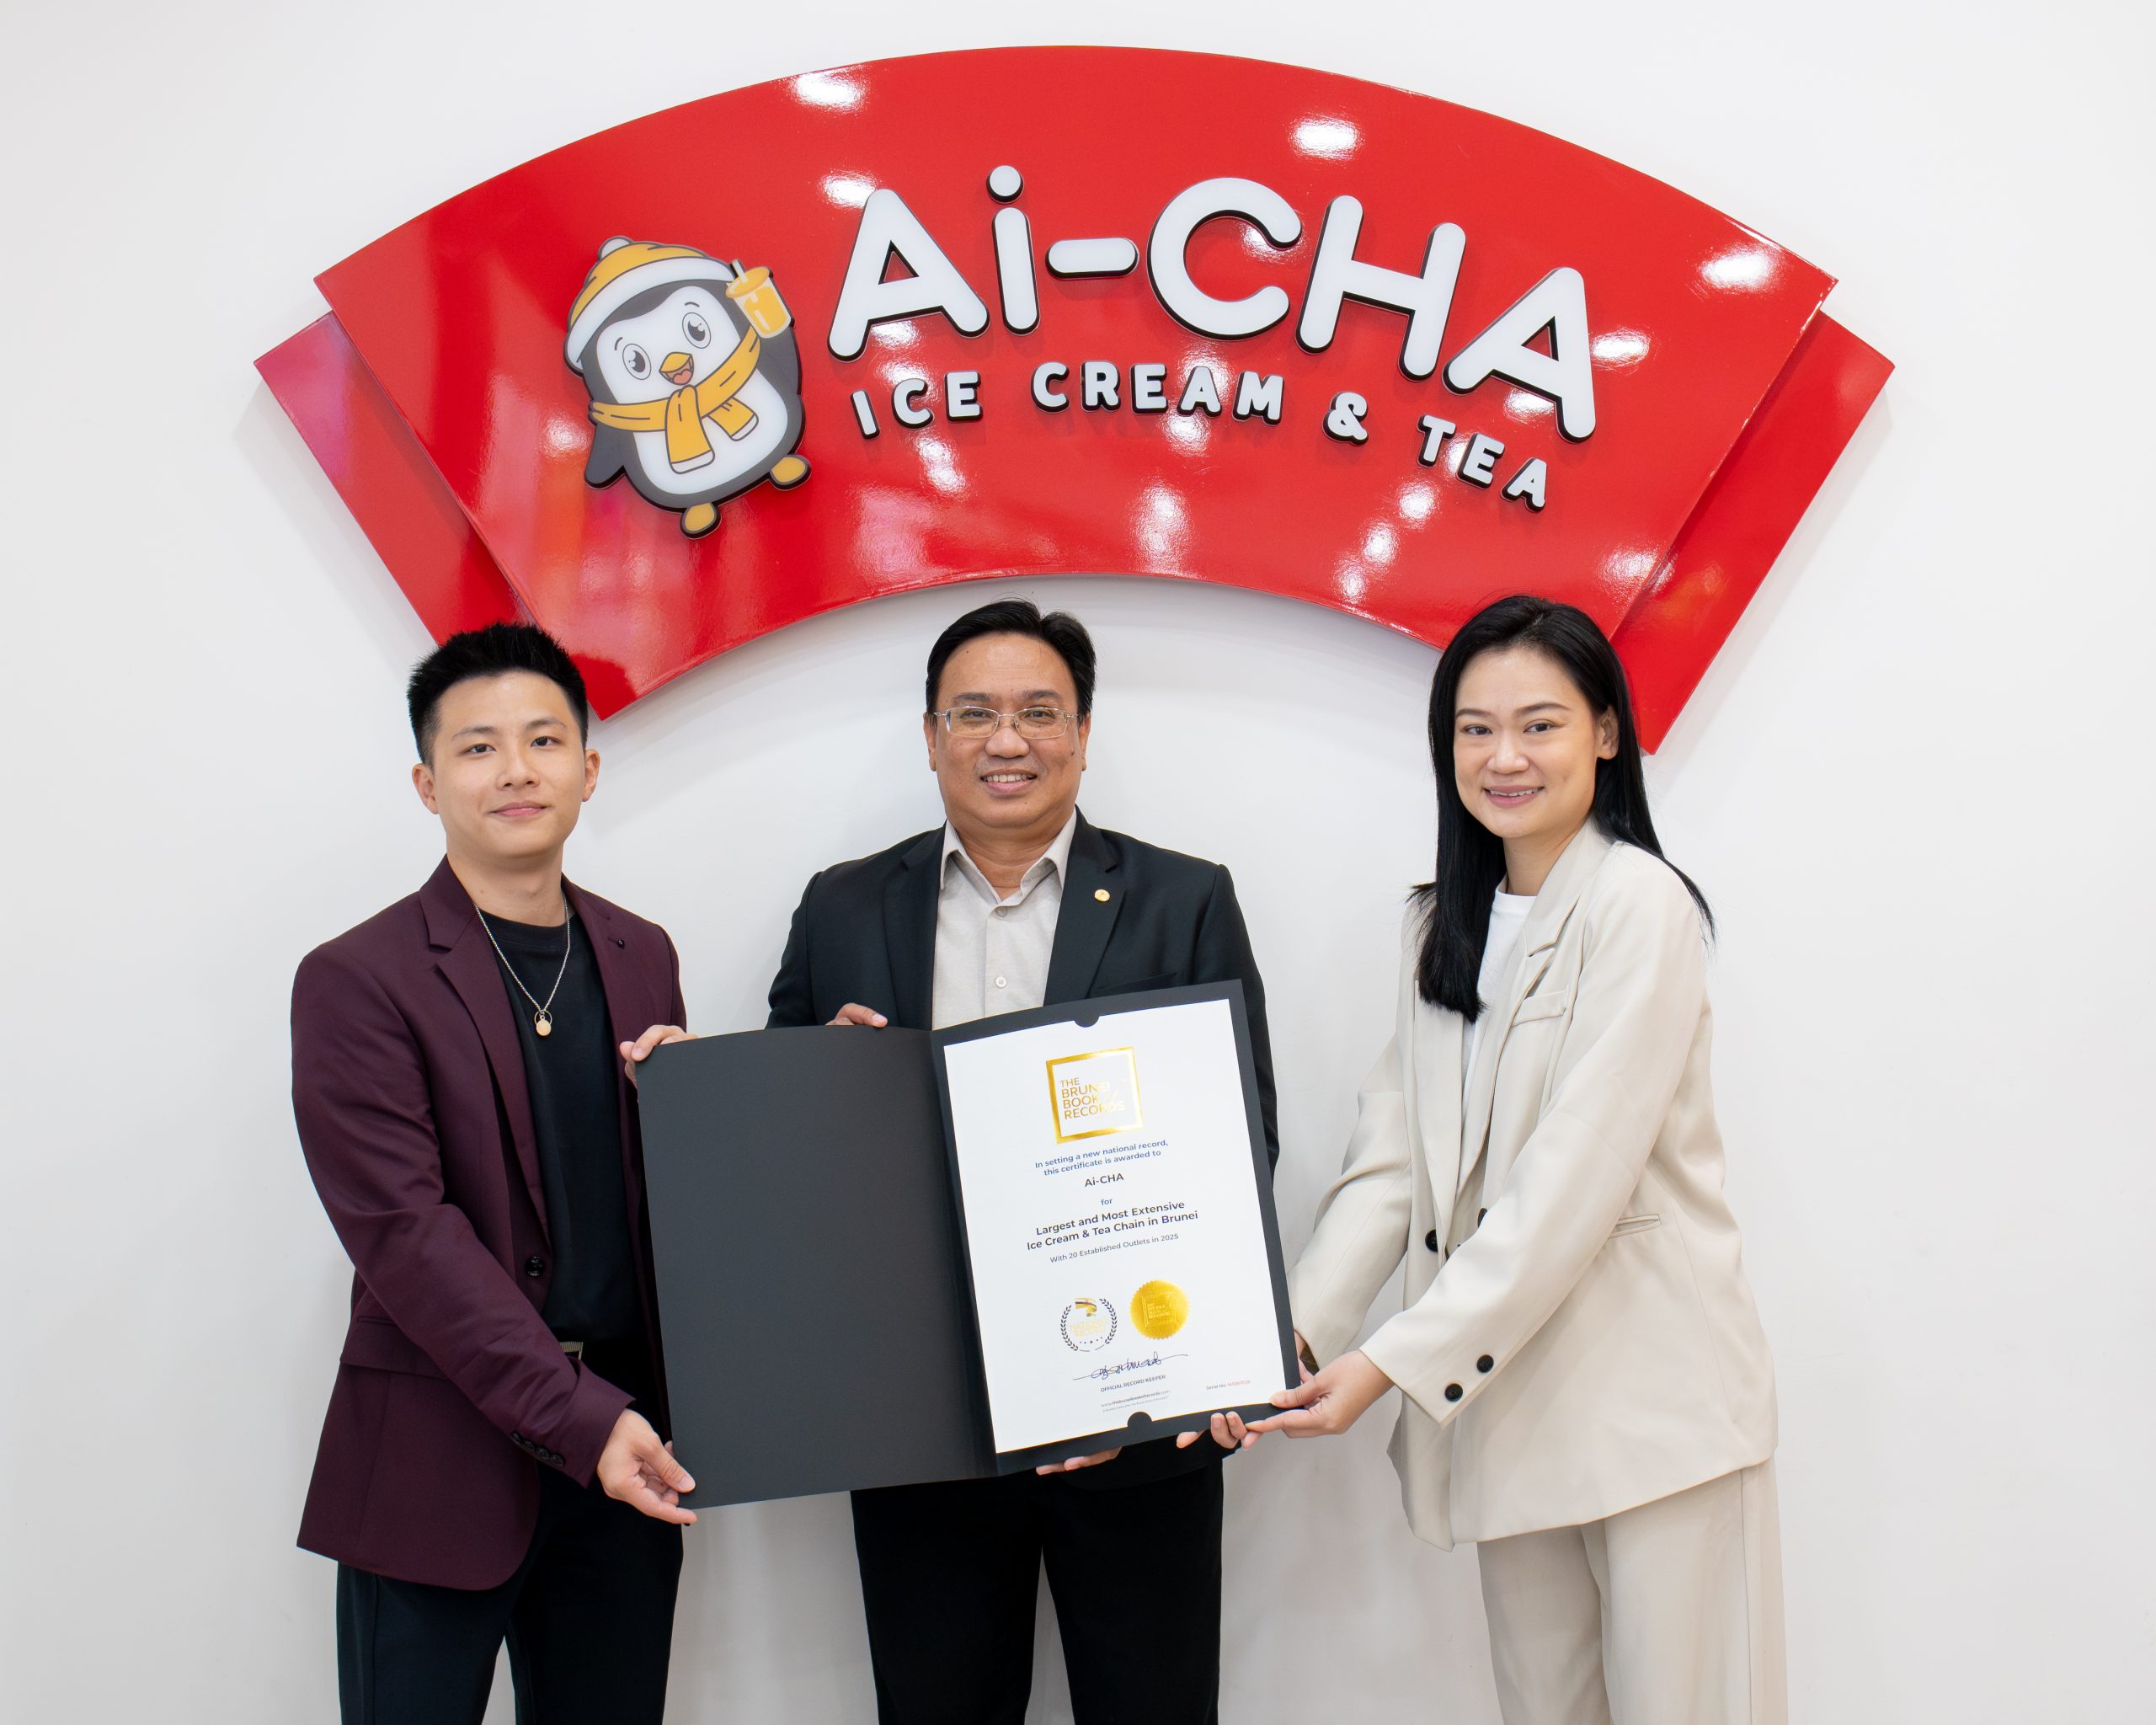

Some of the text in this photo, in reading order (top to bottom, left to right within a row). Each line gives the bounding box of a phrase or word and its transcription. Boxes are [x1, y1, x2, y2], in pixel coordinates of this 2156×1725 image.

[827, 165, 1597, 443] Ai-CHA
[852, 360, 1548, 513] ICE CREAM & TEA
[1060, 1077, 1081, 1088] THE
[1063, 1095, 1099, 1109] BOOK
[1043, 1167, 1059, 1176] this
[1061, 1159, 1103, 1172] certificate
[1113, 1151, 1150, 1162] awarded
[1044, 1155, 1074, 1167] setting
[1082, 1151, 1101, 1159] new
[1102, 1143, 1137, 1156] national
[1138, 1140, 1169, 1150] record,
[1084, 1172, 1124, 1188] Ai-CHA
[1101, 1198, 1113, 1206] for
[1027, 1210, 1198, 1251] Ice Cream & Tea Chain in Brunei
[1036, 1201, 1185, 1236] Largest and Most Extensive
[1049, 1254, 1067, 1263] With
[1079, 1242, 1121, 1257] Established
[1123, 1238, 1150, 1248] Outlets
[1161, 1233, 1179, 1242] 2025
[1100, 1375, 1166, 1392] OFFICIAL RECORD KEEPER
